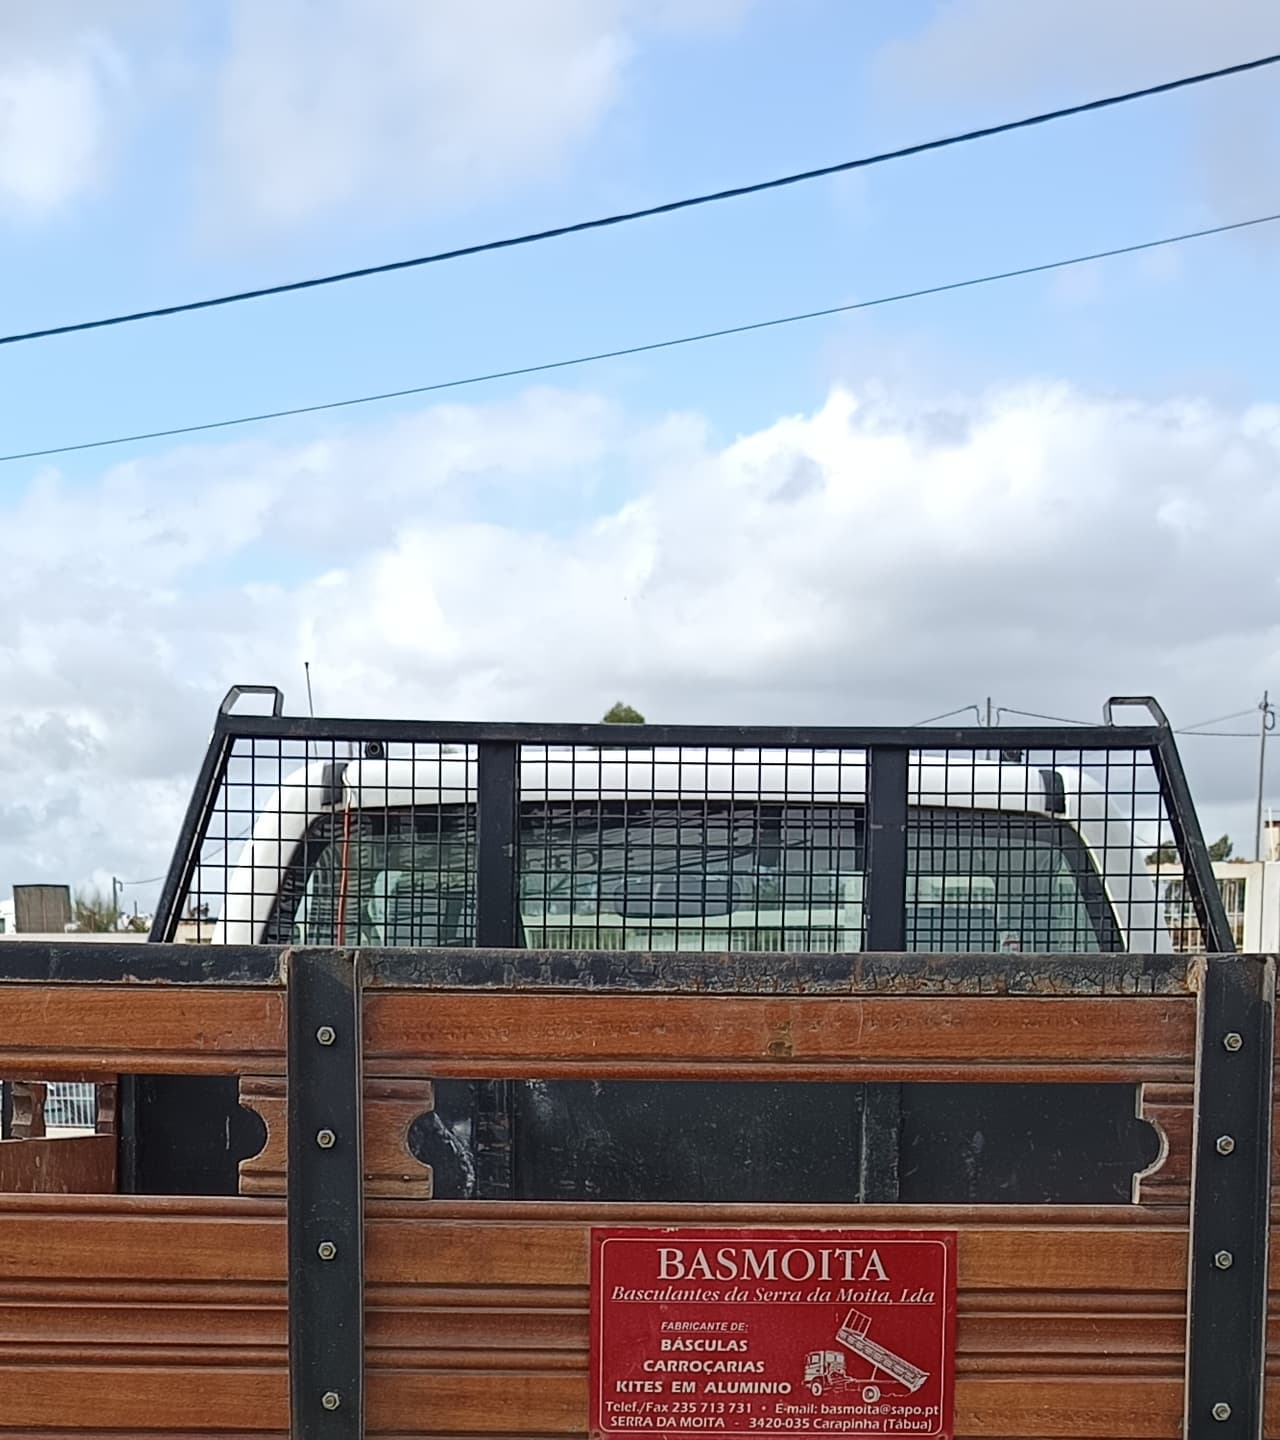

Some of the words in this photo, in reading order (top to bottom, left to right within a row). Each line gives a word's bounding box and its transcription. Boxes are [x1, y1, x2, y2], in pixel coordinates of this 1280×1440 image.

[656, 1247, 890, 1282] BASMOITA
[611, 1285, 720, 1301] Basculantes
[724, 1285, 749, 1302] da
[753, 1286, 802, 1302] Serra
[806, 1286, 831, 1302] da
[836, 1287, 893, 1305] Moita,
[900, 1287, 936, 1303] Lda
[660, 1321, 728, 1331] FABRICANTE
[730, 1322, 749, 1331] DE:
[660, 1336, 748, 1352] BÁSCULAS
[643, 1359, 765, 1375] CARROÇARIAS
[616, 1380, 663, 1393] KITES
[671, 1381, 696, 1393] EM
[704, 1382, 792, 1394] ALUMINIO
[605, 1401, 669, 1415] Telef./Fax
[672, 1402, 697, 1413] 235
[700, 1402, 725, 1413] 713
[728, 1403, 752, 1414] 731
[775, 1403, 818, 1415] E-mail:
[821, 1403, 939, 1417] basmoita@sapo.pt
[610, 1416, 653, 1427] SERRA
[656, 1416, 677, 1428] DA
[680, 1417, 725, 1428] MOITA
[749, 1417, 810, 1429] 3420-035
[813, 1418, 880, 1431] Carapinha
[883, 1418, 933, 1432] (Tábua)
